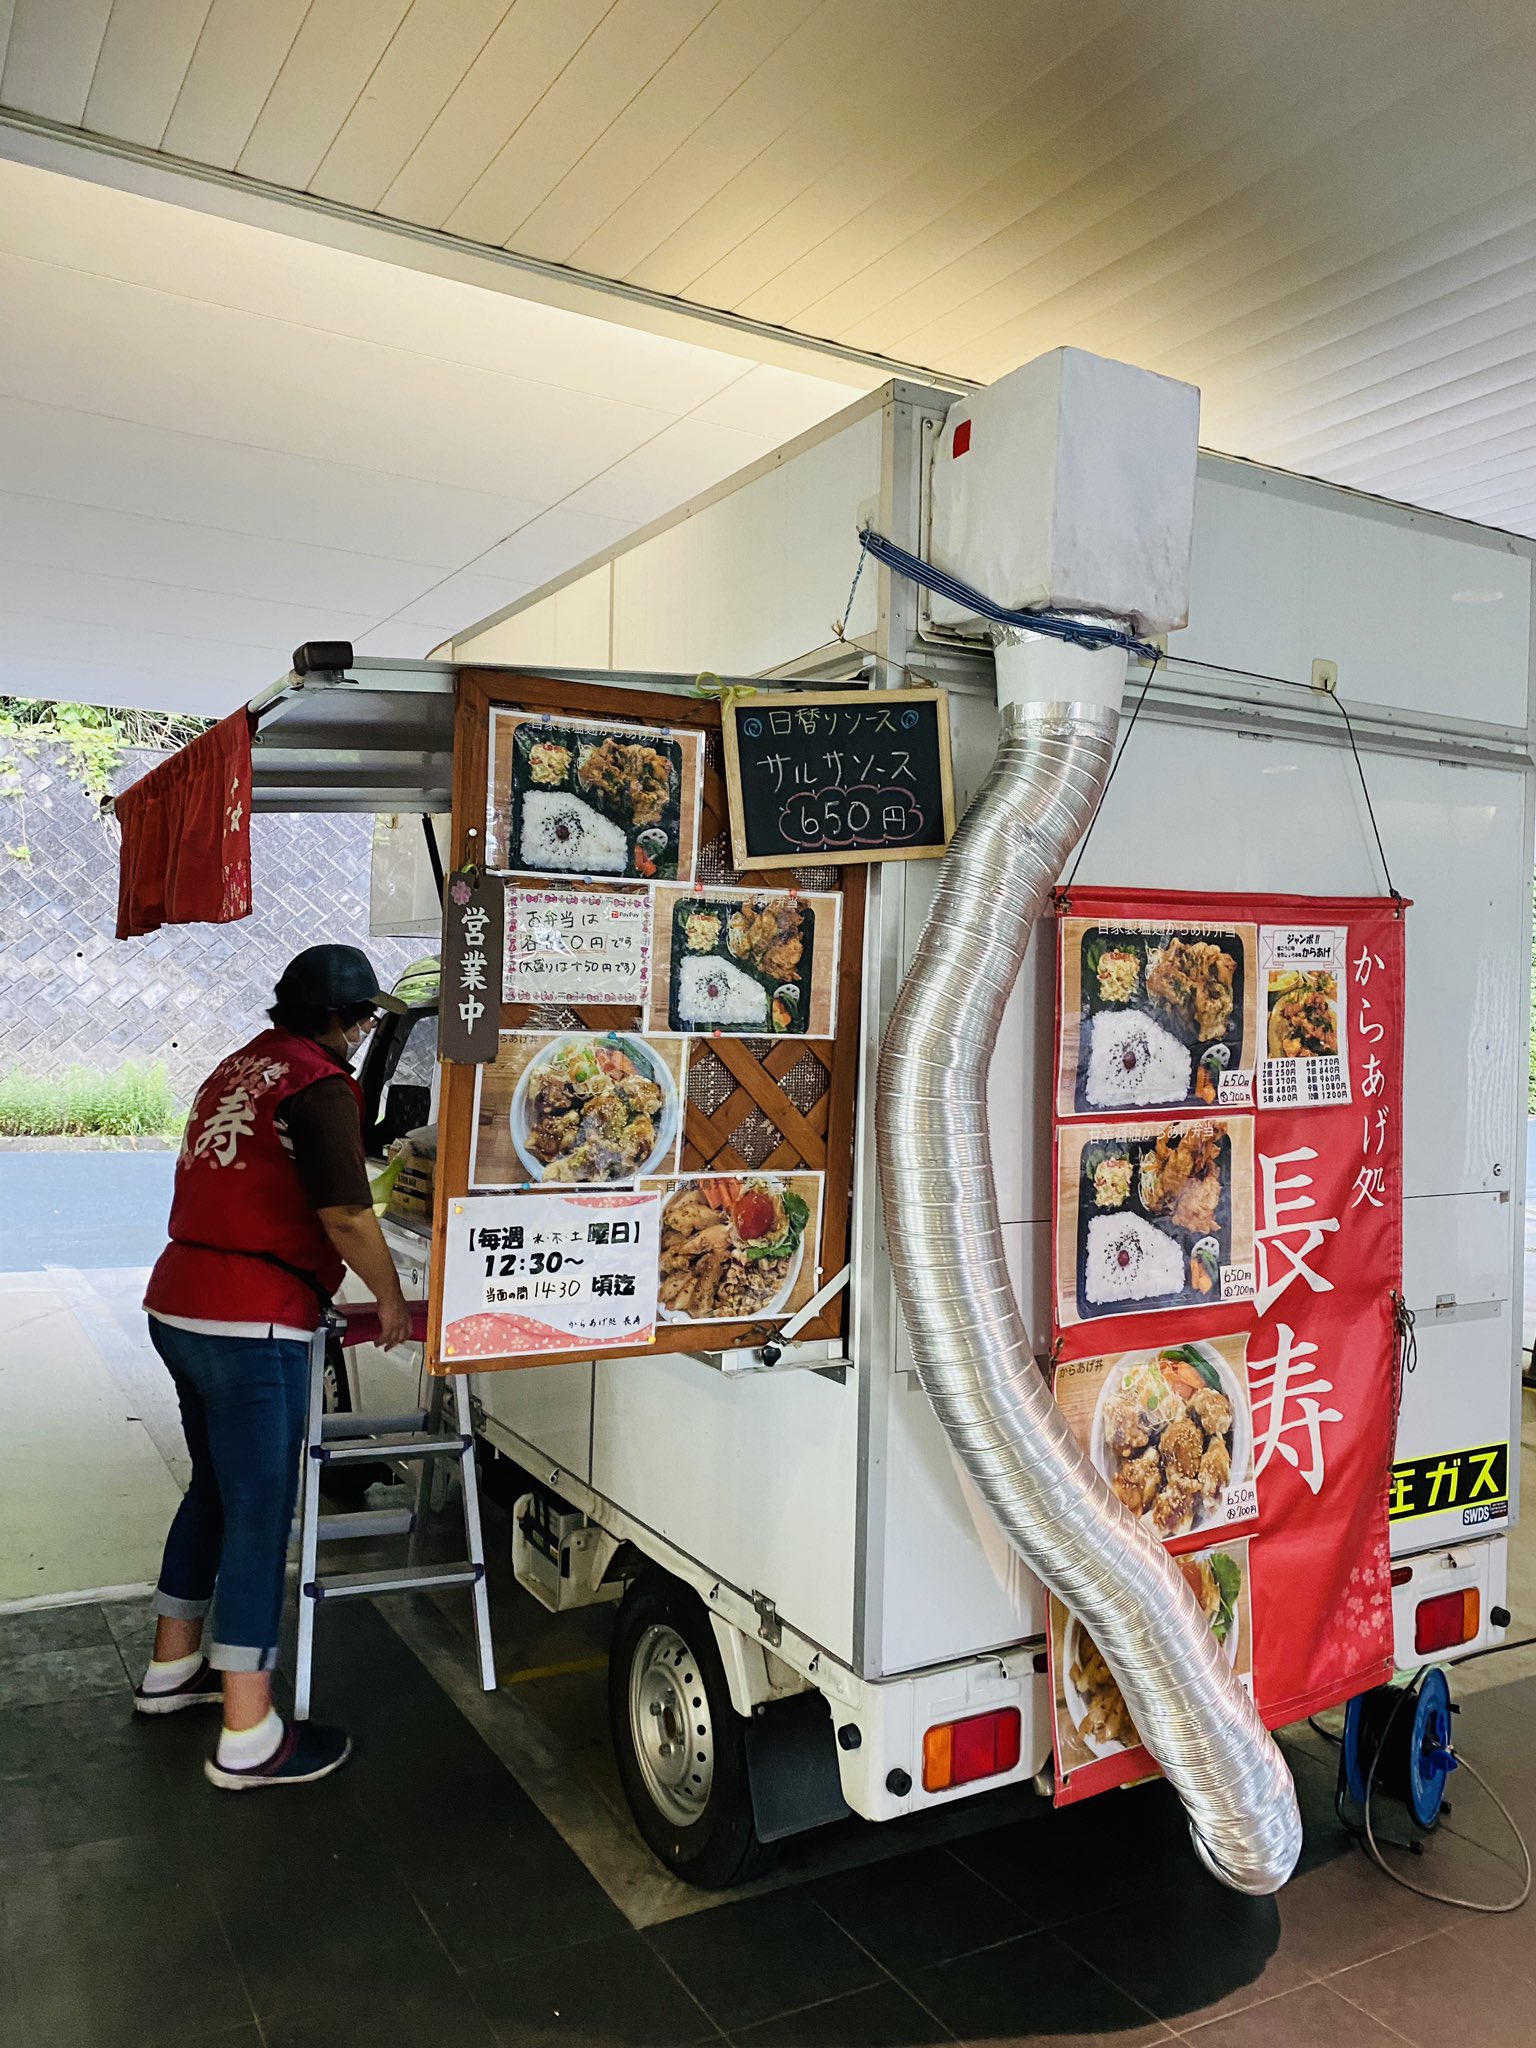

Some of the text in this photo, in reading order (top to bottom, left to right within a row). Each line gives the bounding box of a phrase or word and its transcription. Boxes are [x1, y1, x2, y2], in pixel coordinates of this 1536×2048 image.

[769, 708, 897, 735] 日替りソース
[757, 751, 917, 793] サルサソース
[801, 801, 906, 835] 650円
[458, 906, 491, 1035] 営業中
[1351, 945, 1389, 1209] からあげ処
[1248, 1146, 1344, 1495] 長寿
[1463, 1505, 1490, 1524] SWDS
